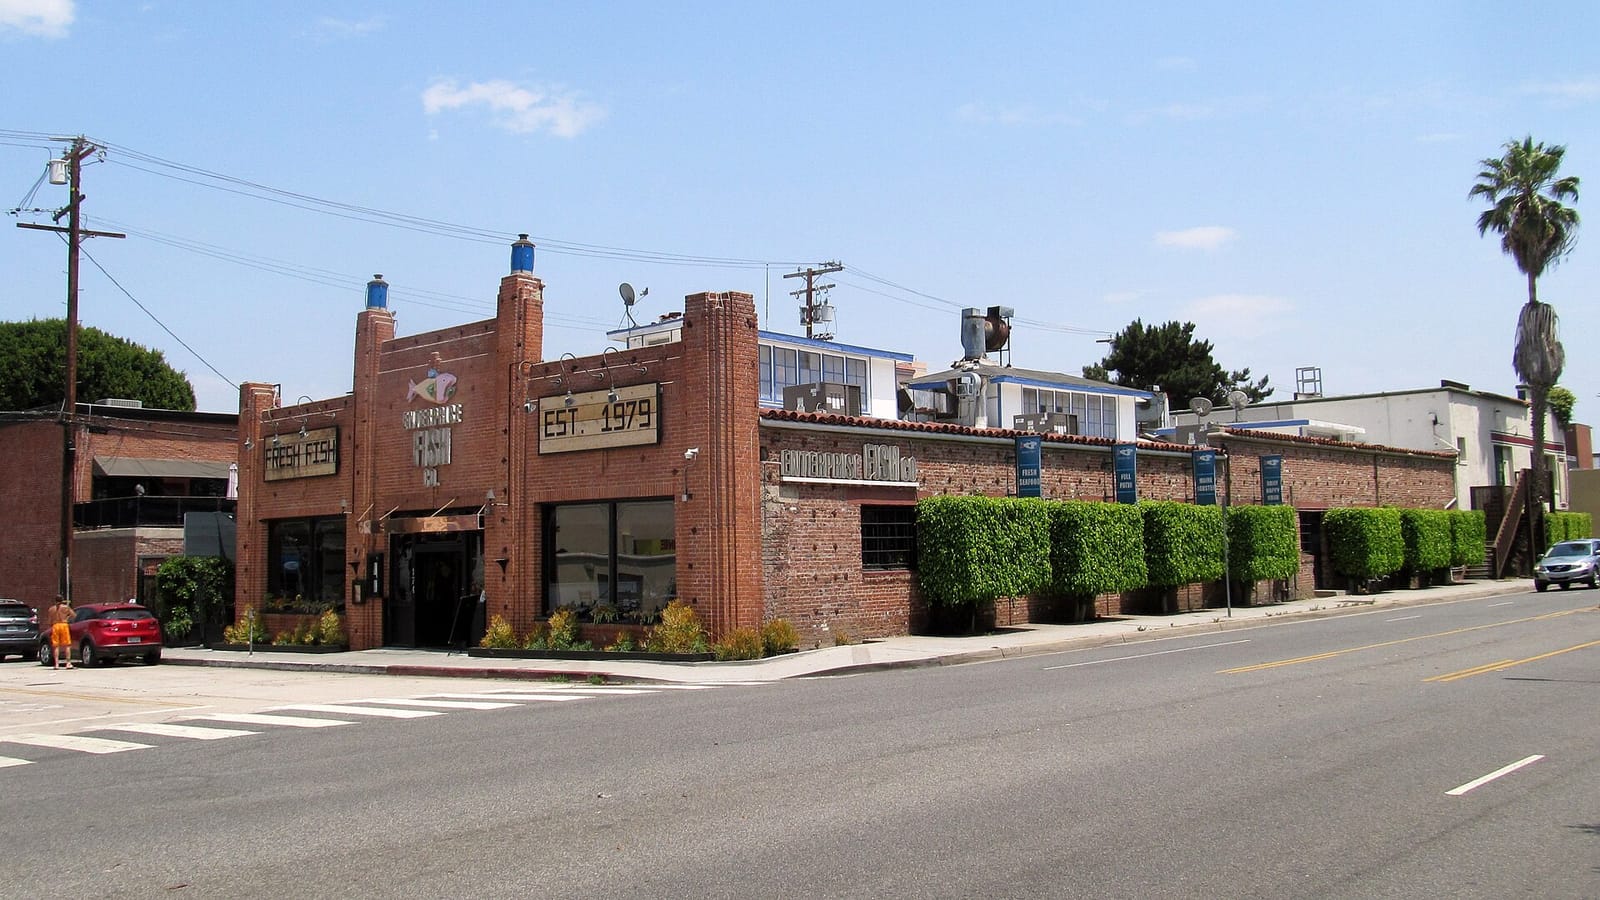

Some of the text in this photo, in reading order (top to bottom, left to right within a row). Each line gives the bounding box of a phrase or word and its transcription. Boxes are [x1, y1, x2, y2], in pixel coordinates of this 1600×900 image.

[544, 399, 651, 438] EST. 1979
[265, 439, 337, 469] FRESH FISH
[412, 427, 452, 467] FISH
[780, 449, 862, 480] ENTERPRISE
[863, 443, 900, 481] FISH
